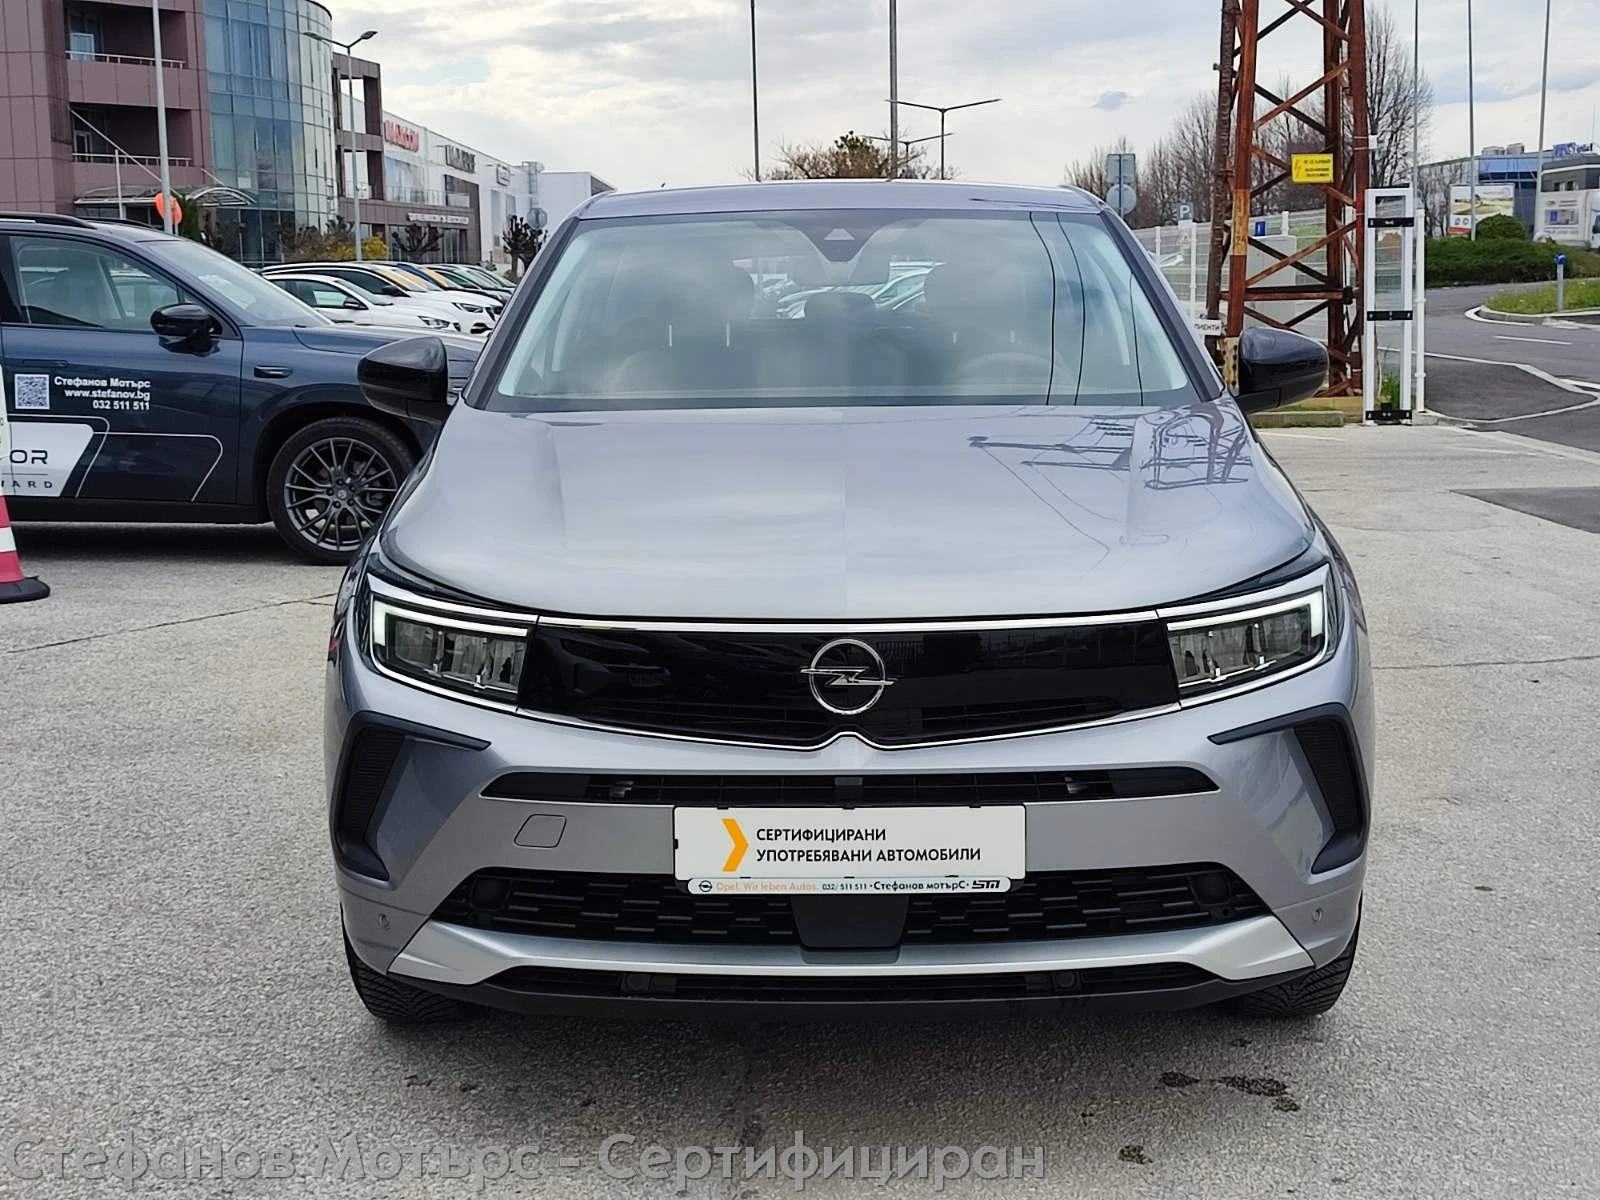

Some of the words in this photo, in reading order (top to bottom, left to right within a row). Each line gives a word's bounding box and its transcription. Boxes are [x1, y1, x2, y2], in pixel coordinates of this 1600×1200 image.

[1180, 205, 1190, 218] P
[54, 376, 107, 388] Стефанов
[110, 378, 151, 389] Мотърс
[64, 389, 151, 401] www.stefanov.bg
[92, 400, 111, 409] 032
[113, 401, 130, 410] 511
[133, 402, 150, 410] 511
[756, 828, 886, 843] СЕРТИФИЦИРАНИ
[756, 850, 872, 862] УПОТРЕБЯВАНИ
[876, 848, 981, 861] АВТОМОБИЛИ
[760, 881, 788, 890] leben
